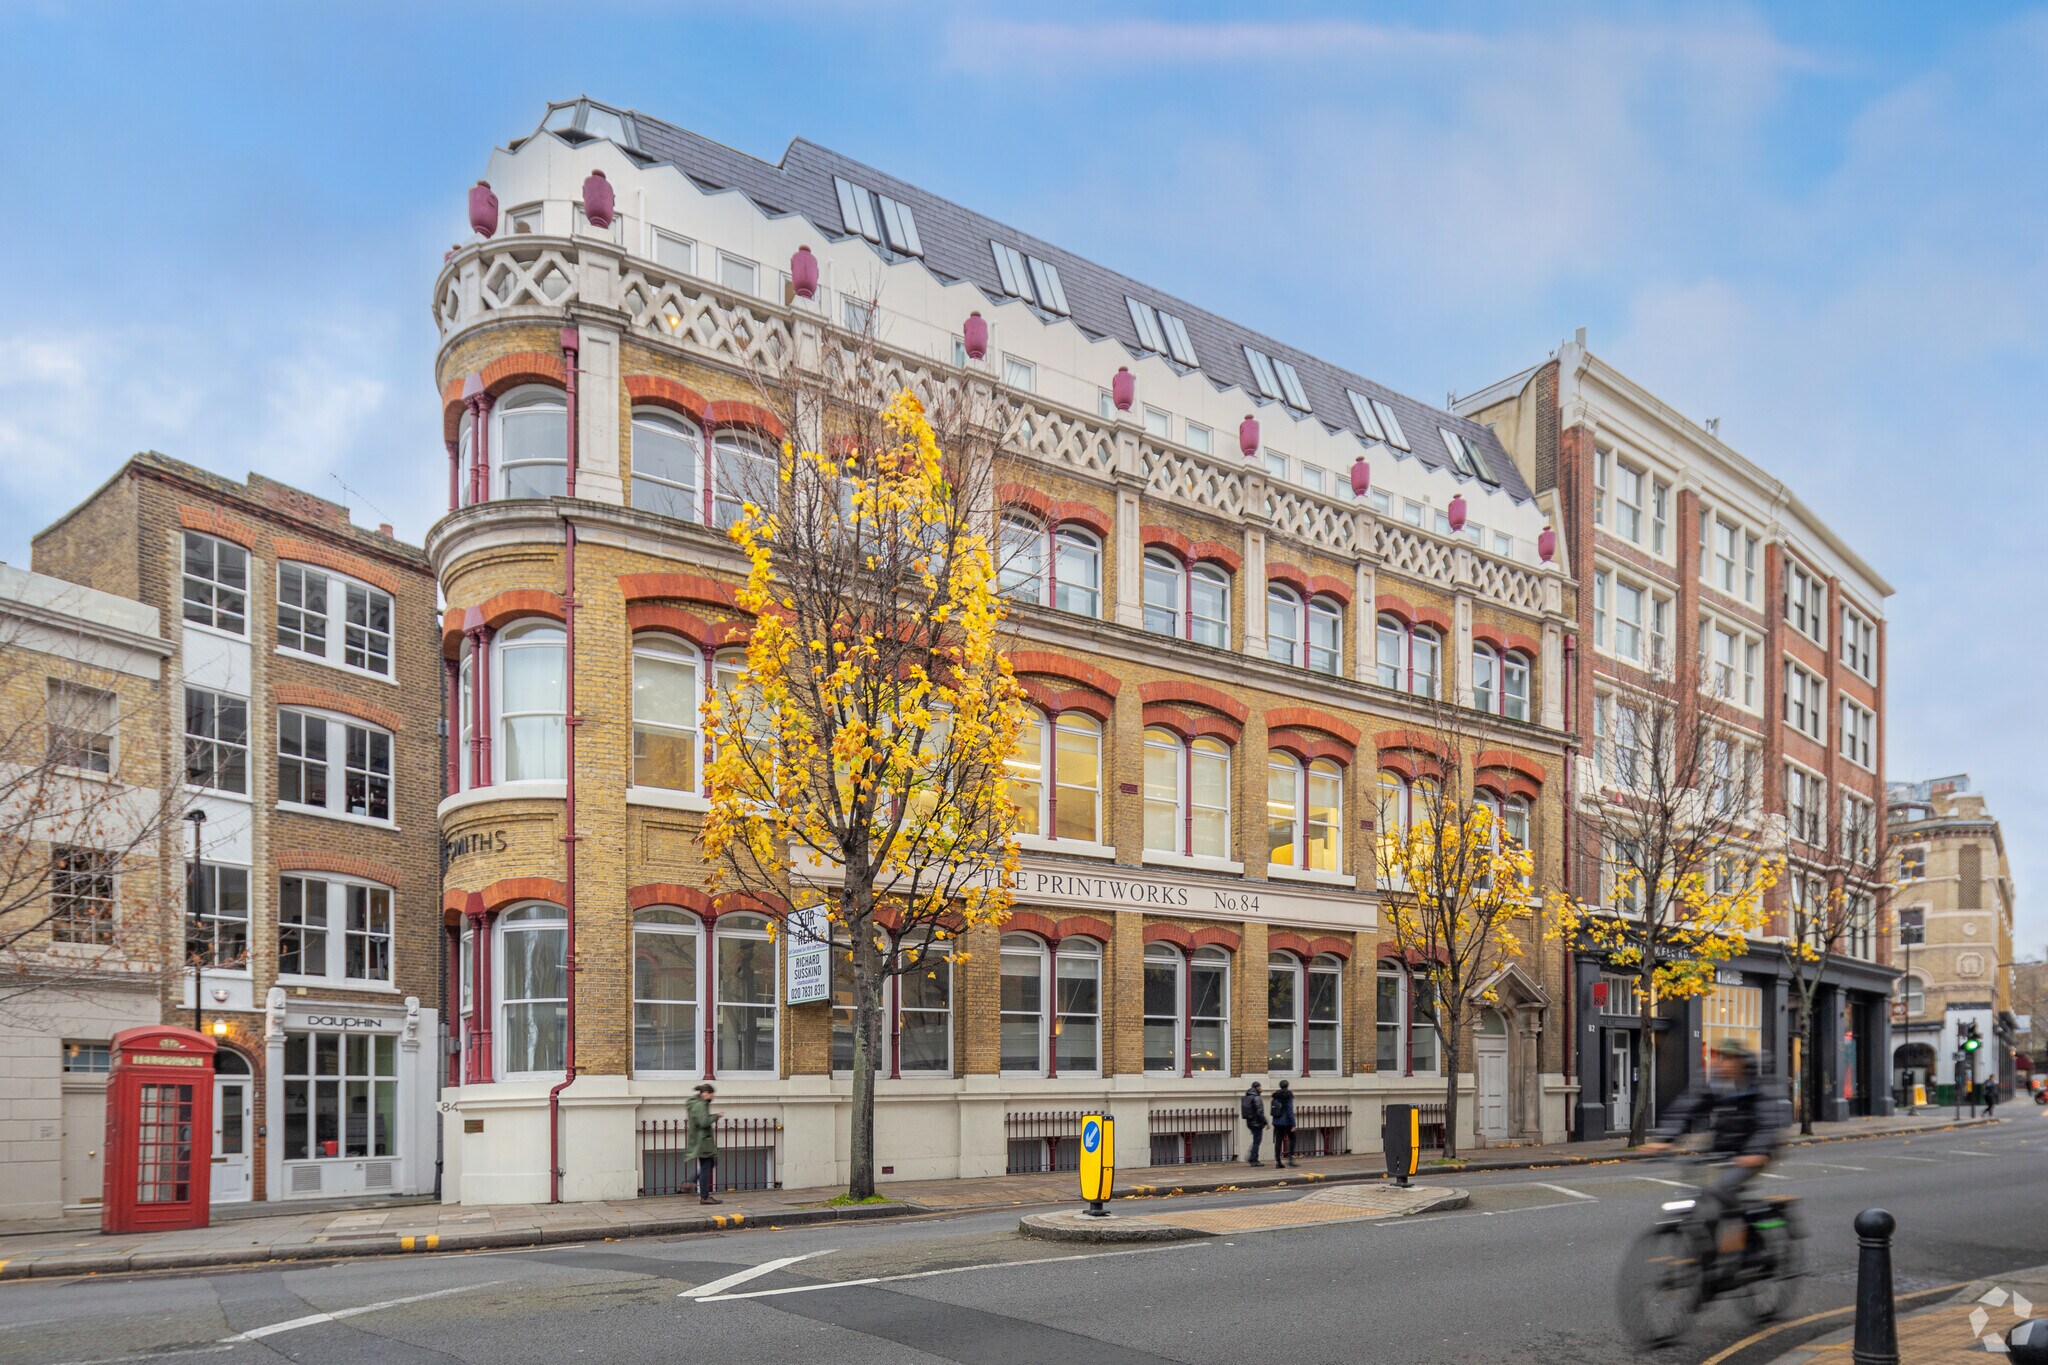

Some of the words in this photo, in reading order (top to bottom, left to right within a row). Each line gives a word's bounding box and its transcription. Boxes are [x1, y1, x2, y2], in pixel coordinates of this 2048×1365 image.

[1036, 873, 1189, 906] PRINTWORKS
[800, 910, 815, 927] FOR
[796, 953, 820, 968] RICHARD
[794, 965, 822, 979] SUSSKIND
[791, 987, 801, 999] 020
[1594, 996, 1606, 1005] 82
